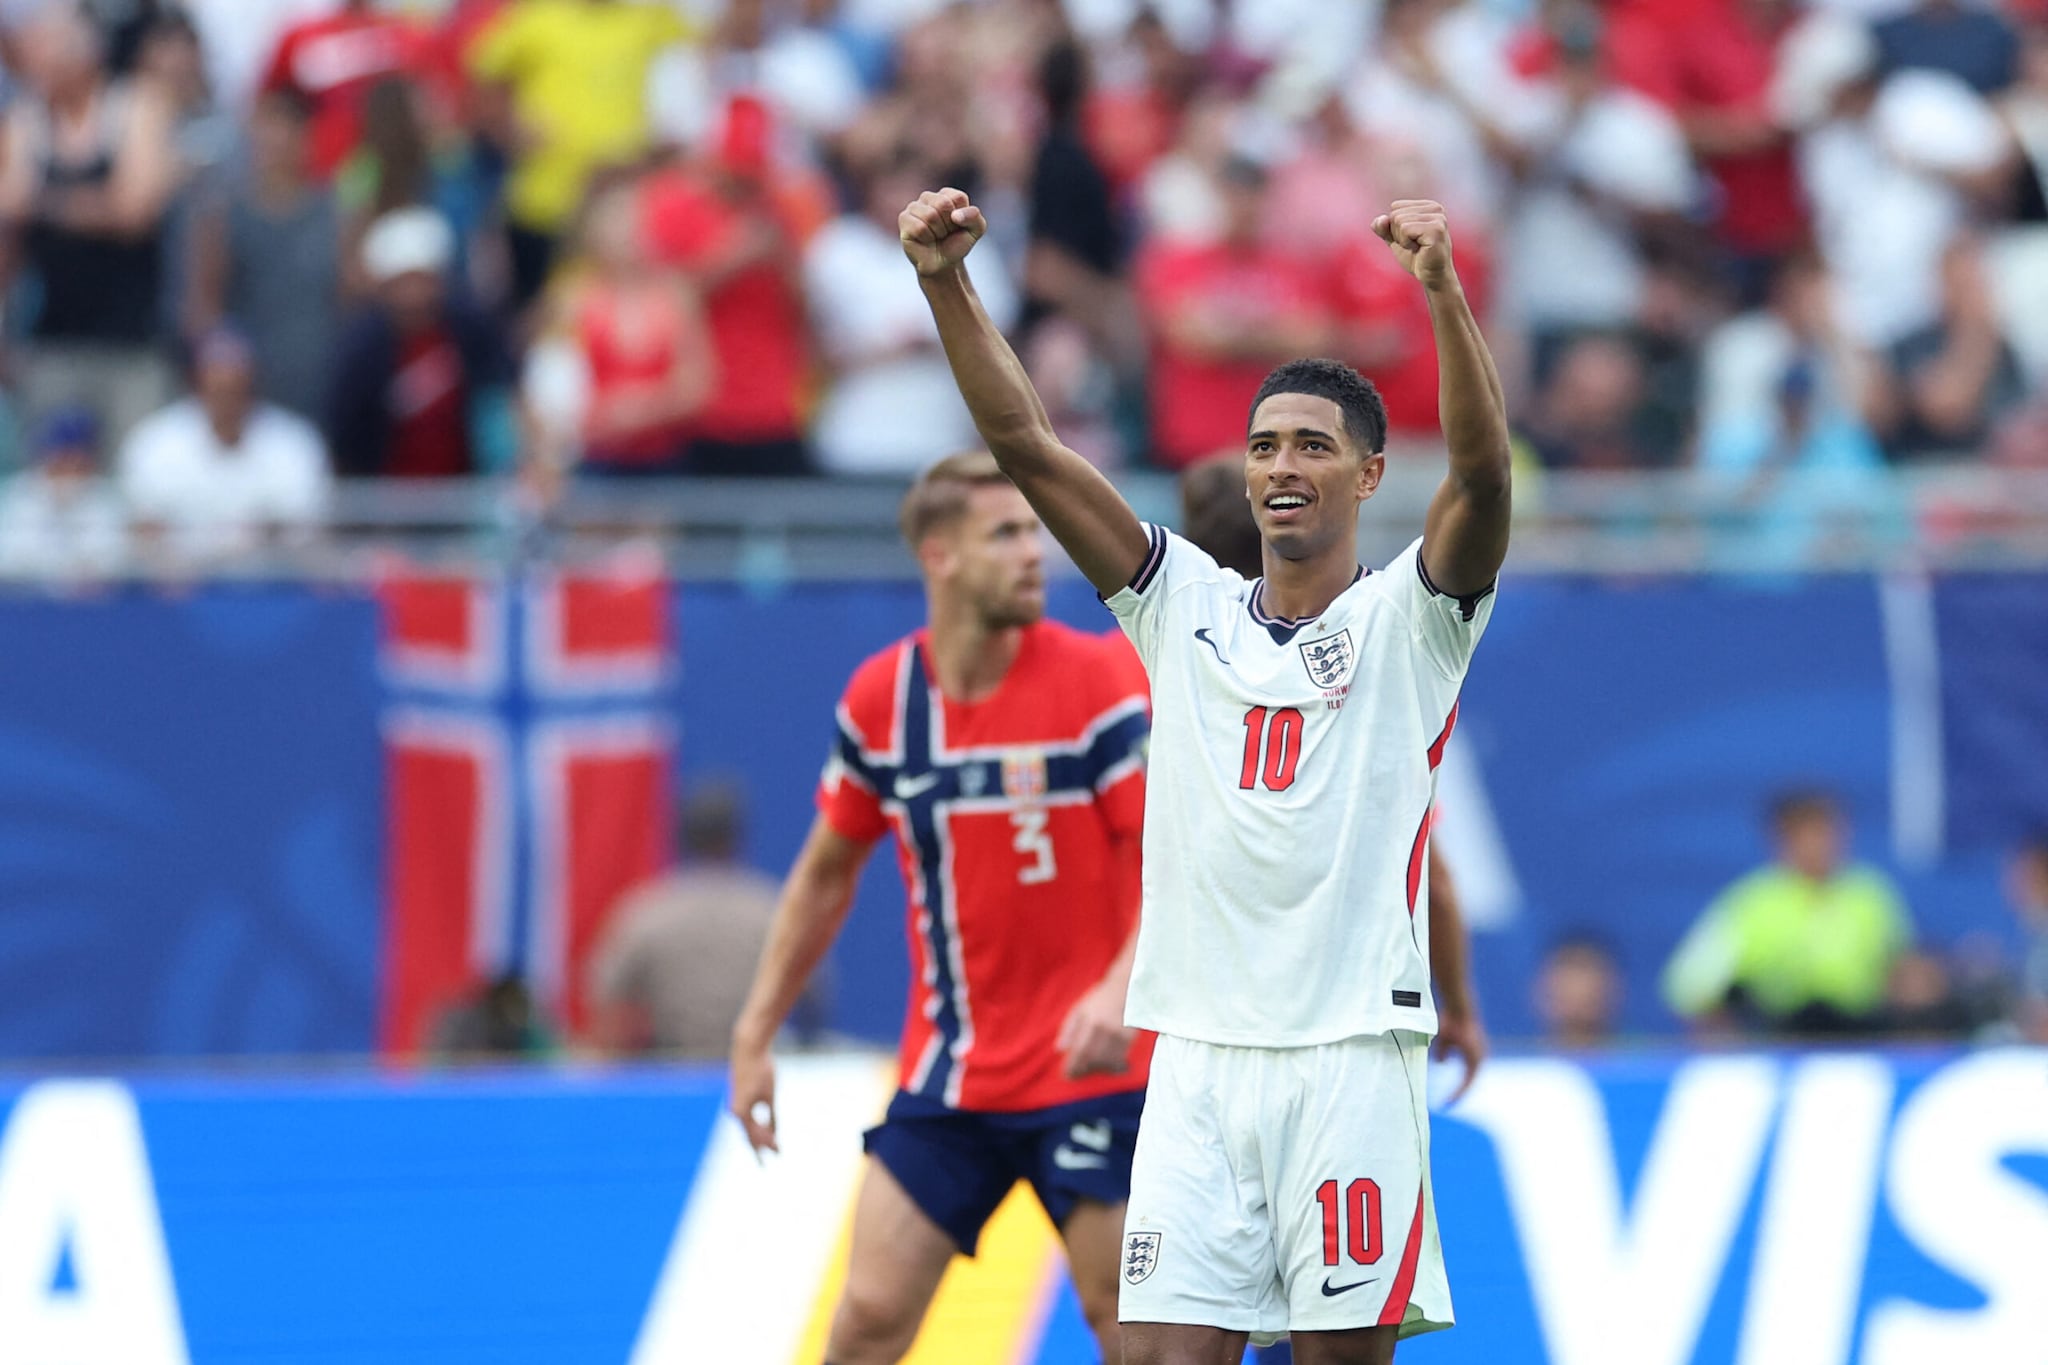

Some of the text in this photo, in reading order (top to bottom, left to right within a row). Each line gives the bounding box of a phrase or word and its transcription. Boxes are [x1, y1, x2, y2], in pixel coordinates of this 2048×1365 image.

[1239, 705, 1304, 791] 10
[1009, 808, 1056, 884] 3
[1316, 1178, 1383, 1266] 10
